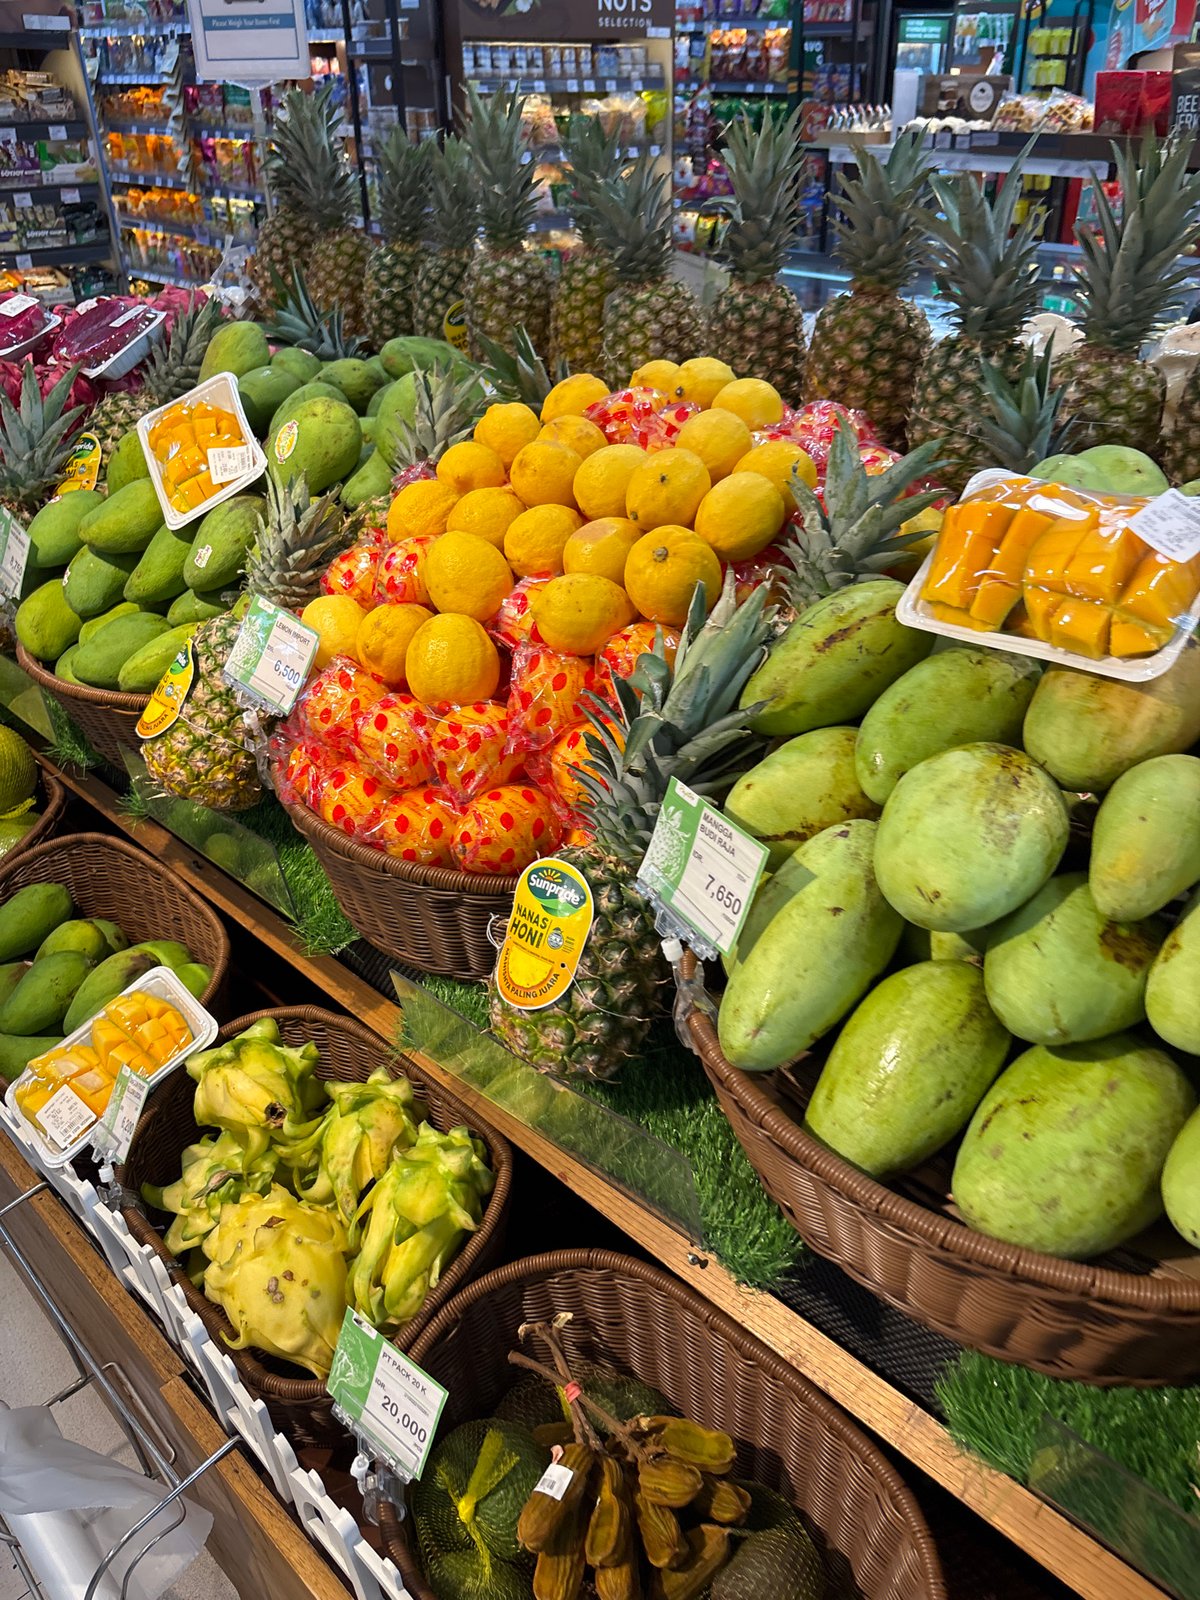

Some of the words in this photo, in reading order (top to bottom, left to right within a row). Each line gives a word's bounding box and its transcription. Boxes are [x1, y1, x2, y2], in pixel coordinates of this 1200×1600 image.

[598, 16, 653, 28] SELECTION
[275, 620, 293, 636] LEMON
[292, 630, 310, 647] IMPORT
[274, 659, 301, 685] 6,500
[699, 823, 718, 842] BUDI
[716, 836, 736, 858] RAJA
[703, 812, 733, 841] MANGGA
[529, 873, 580, 905] Sunpride
[704, 873, 742, 916] 7,650
[515, 903, 549, 930] NANAS
[509, 916, 544, 949] HONI
[510, 985, 538, 999] PALING
[538, 972, 560, 997] JUARA
[382, 1351, 392, 1362] PT
[391, 1360, 411, 1381] PACK
[411, 1377, 421, 1389] 20
[420, 1385, 427, 1396] K
[380, 1394, 427, 1443] 20,000
